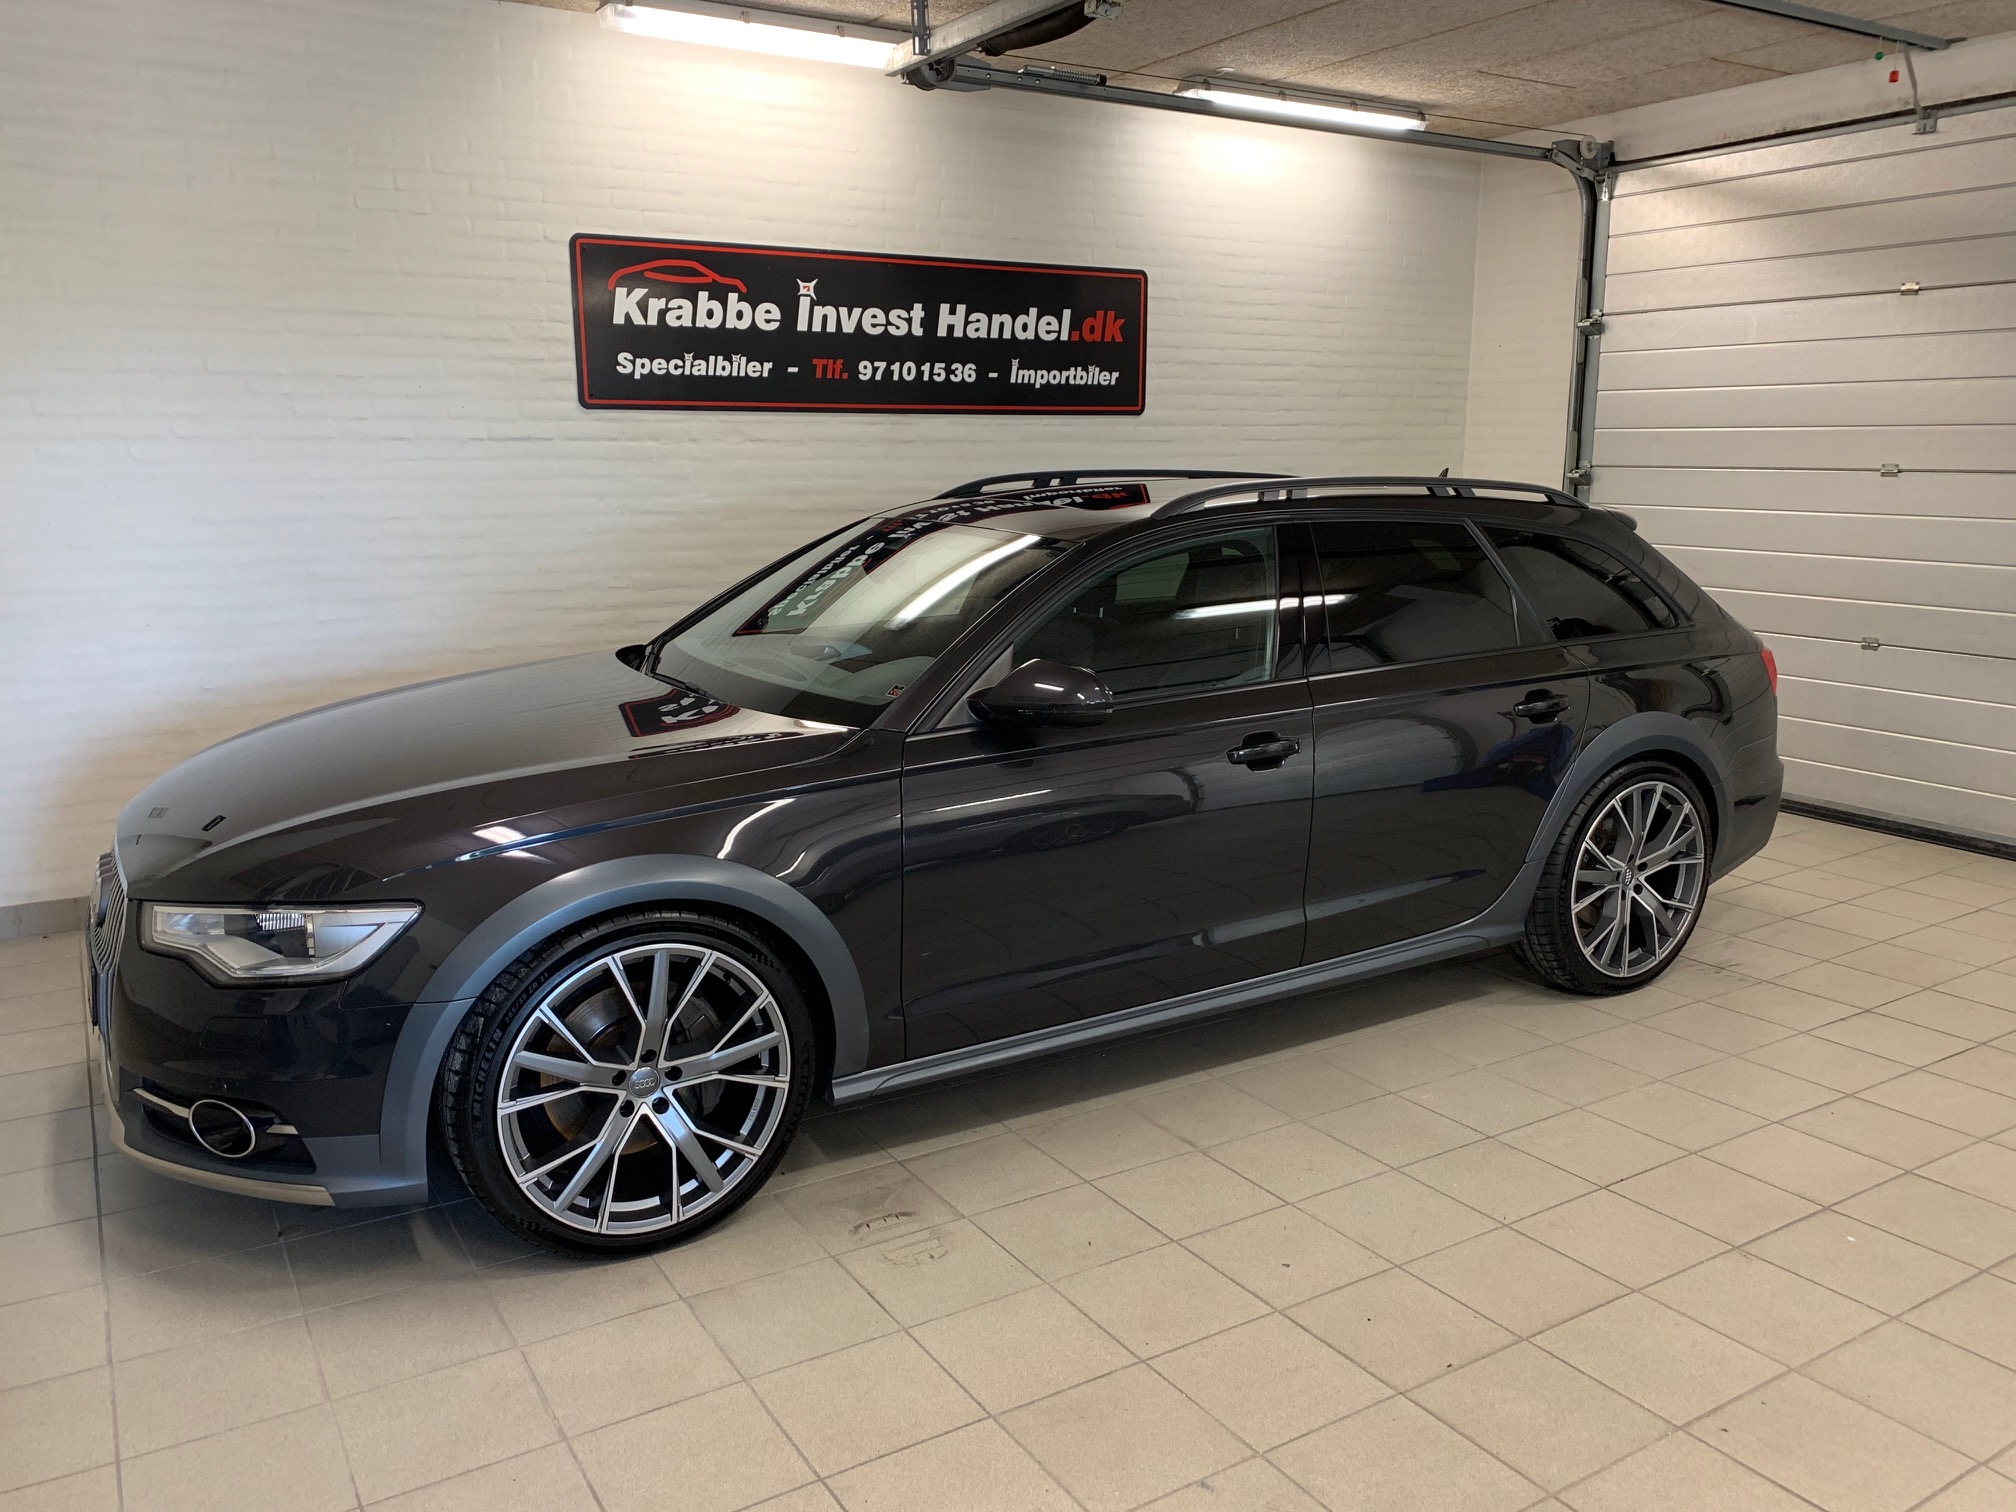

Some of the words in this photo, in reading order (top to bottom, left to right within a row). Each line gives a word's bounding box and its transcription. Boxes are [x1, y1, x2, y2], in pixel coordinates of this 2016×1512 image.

[612, 287, 782, 331] Krabbe
[796, 279, 925, 337] Invest
[937, 304, 1125, 342] Handel.dk
[616, 352, 773, 379] Specialbiler
[812, 359, 848, 379] Tlf.
[1010, 357, 1120, 389] Importbiler
[472, 1028, 503, 1116] MICHELIN
